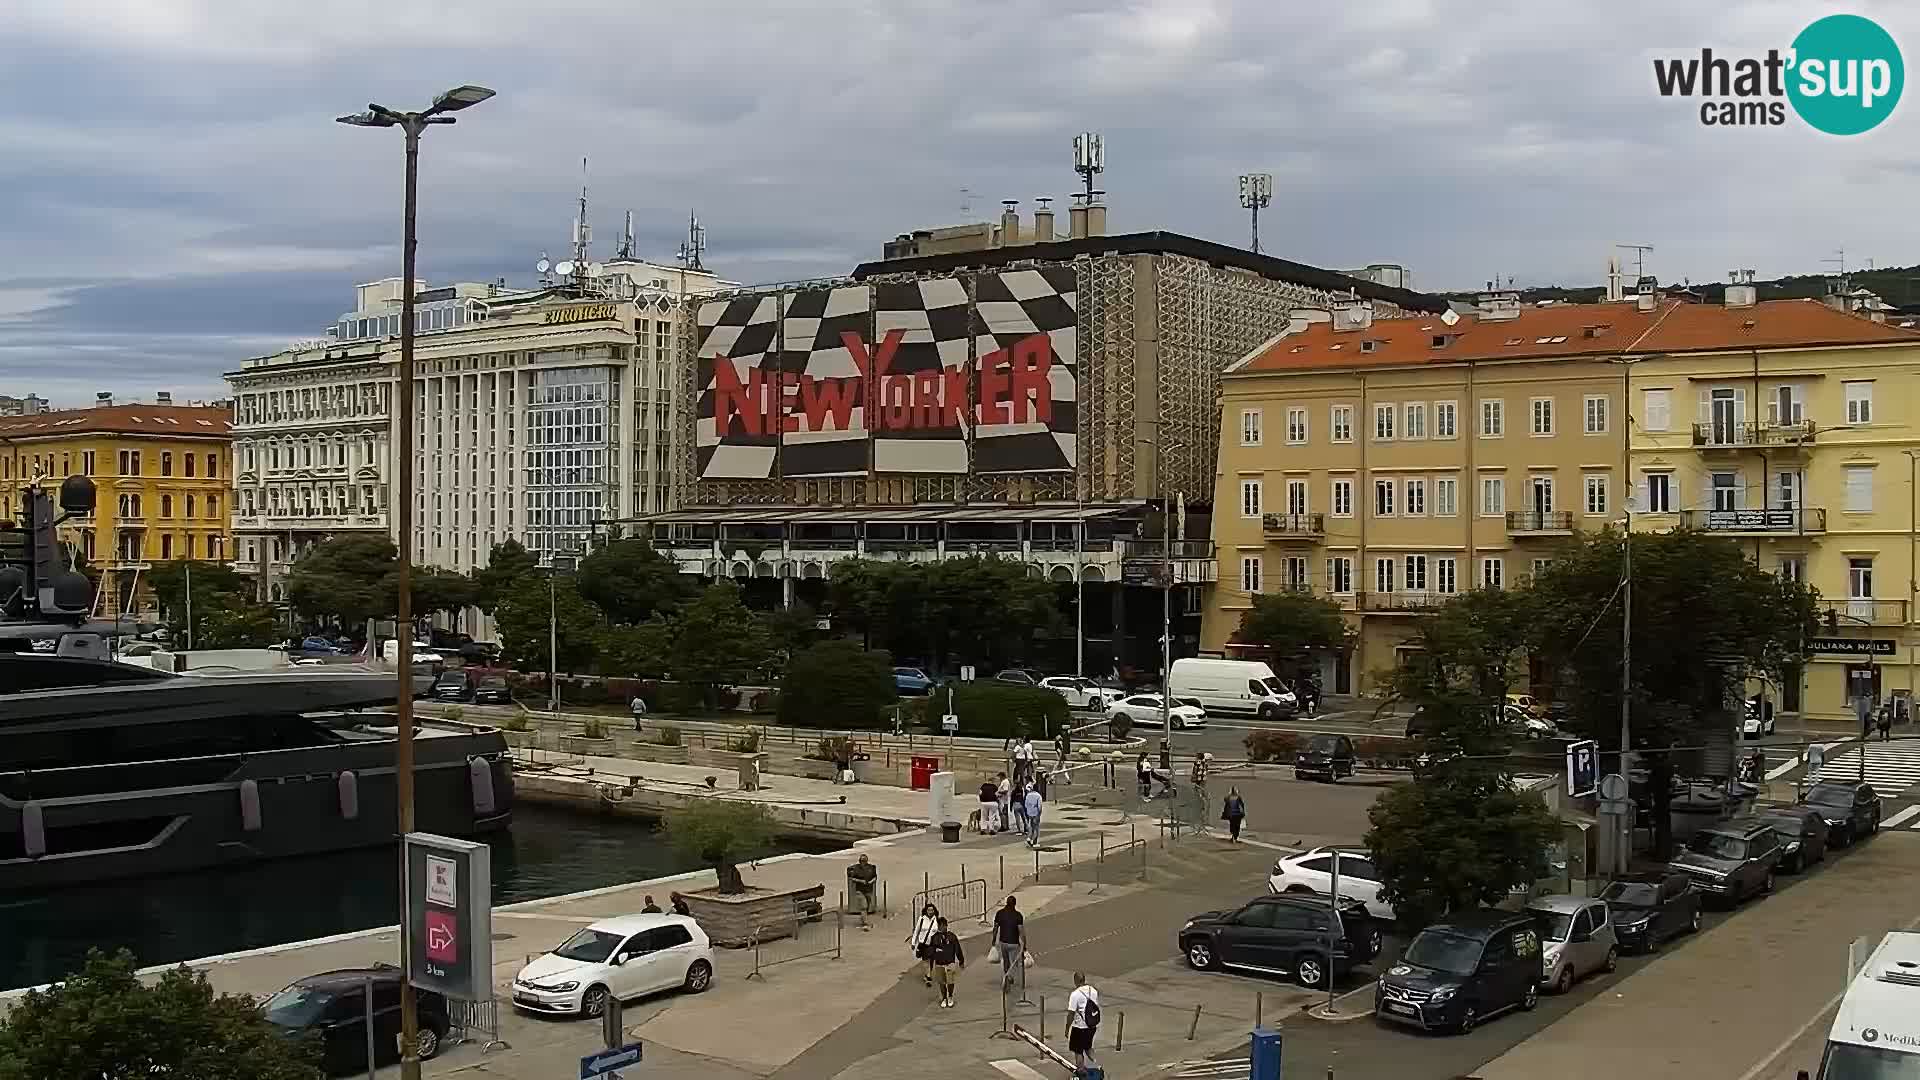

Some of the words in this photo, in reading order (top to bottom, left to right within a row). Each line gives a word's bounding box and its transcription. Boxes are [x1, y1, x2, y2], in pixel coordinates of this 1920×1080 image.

[545, 304, 616, 323] EUROHERC
[1807, 642, 1853, 650] JULIANA
[1857, 643, 1890, 651] NAILS
